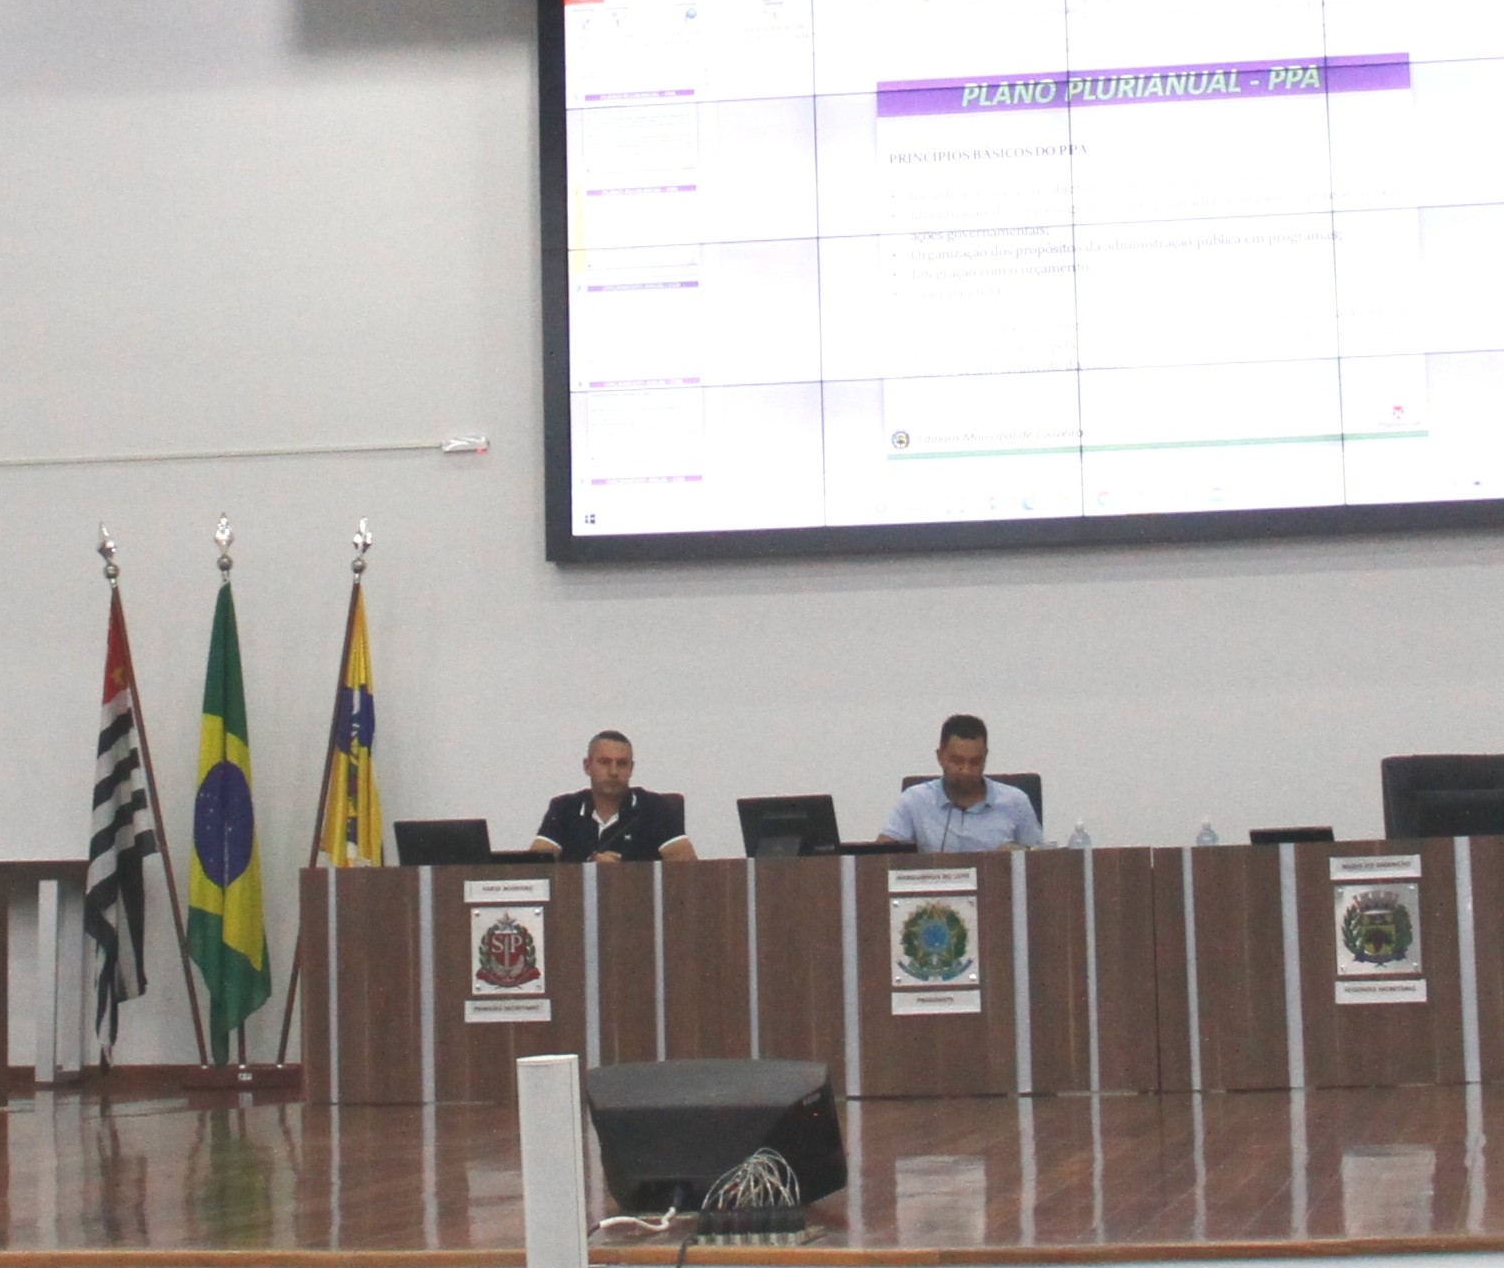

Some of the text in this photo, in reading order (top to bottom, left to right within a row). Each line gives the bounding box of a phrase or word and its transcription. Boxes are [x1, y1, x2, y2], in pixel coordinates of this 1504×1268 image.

[961, 78, 1056, 108] PLANO
[1064, 68, 1242, 102] PLURIANUAL
[1268, 64, 1321, 91] PPA
[1035, 145, 1057, 158] DO
[1059, 143, 1089, 156] PPA
[911, 244, 988, 262] Organização
[990, 244, 1013, 257] dos
[1015, 242, 1083, 259] propósitos
[1085, 240, 1101, 252] da
[1197, 231, 1241, 250] pública
[1244, 235, 1264, 245] em
[1019, 429, 1032, 439] de
